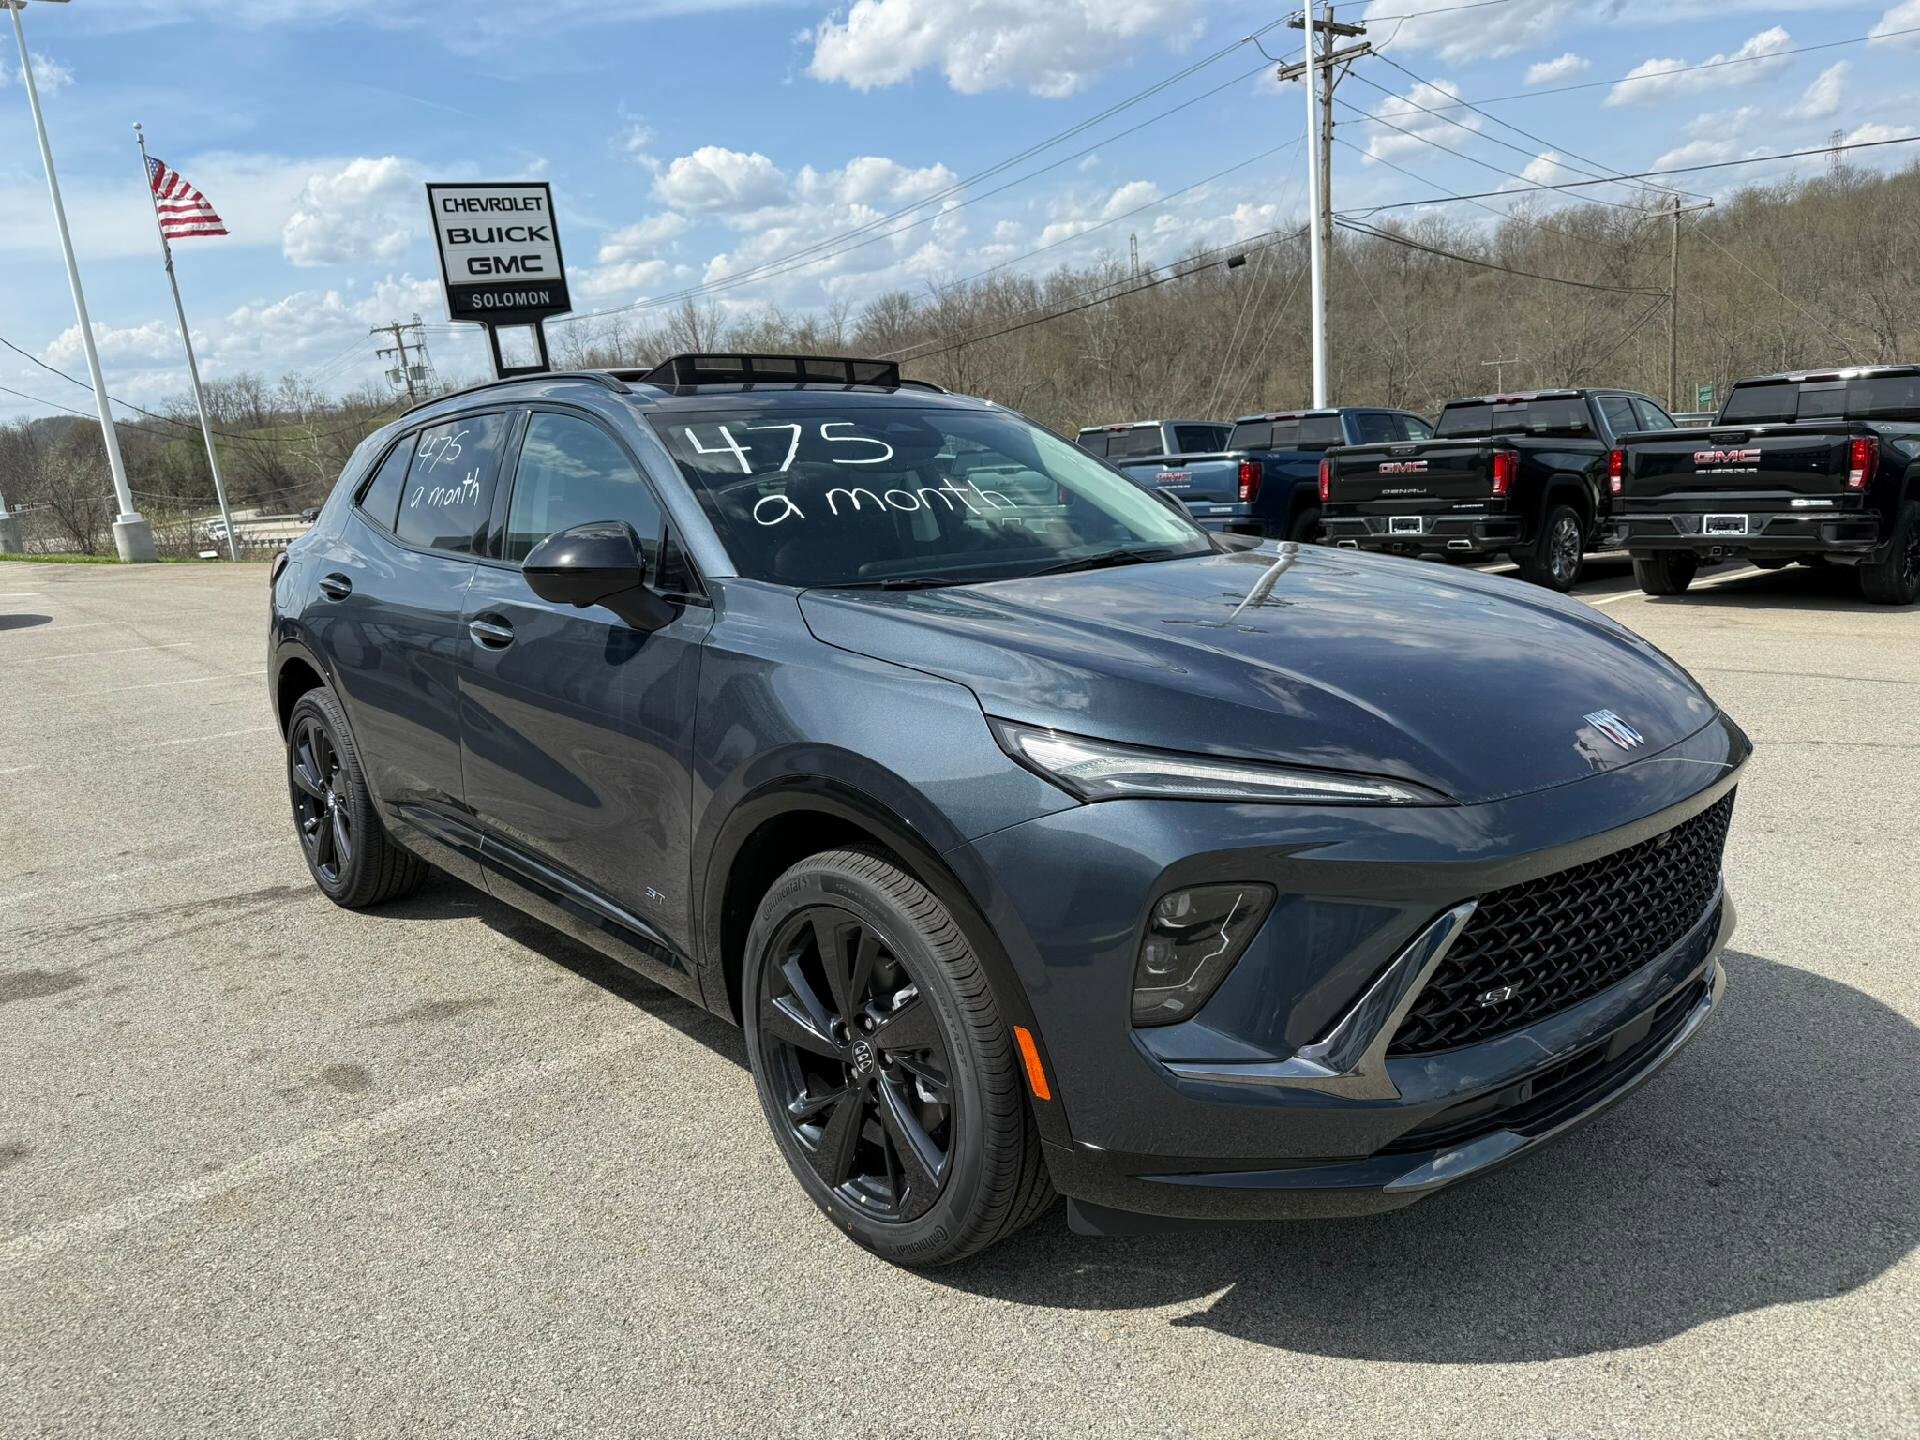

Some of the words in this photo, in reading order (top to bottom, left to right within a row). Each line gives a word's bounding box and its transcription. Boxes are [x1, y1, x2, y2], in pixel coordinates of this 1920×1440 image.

[442, 197, 542, 213] CHEVROLET
[446, 226, 550, 244] BUICK
[467, 255, 543, 275] GMC
[472, 291, 550, 308] SOLOMON
[418, 430, 470, 474] 475
[684, 422, 894, 474] 475
[1694, 448, 1761, 464] GMC
[1379, 460, 1428, 473] GMC
[411, 486, 425, 509] a
[427, 467, 480, 508] month
[753, 495, 805, 525] a
[825, 478, 1018, 516] month
